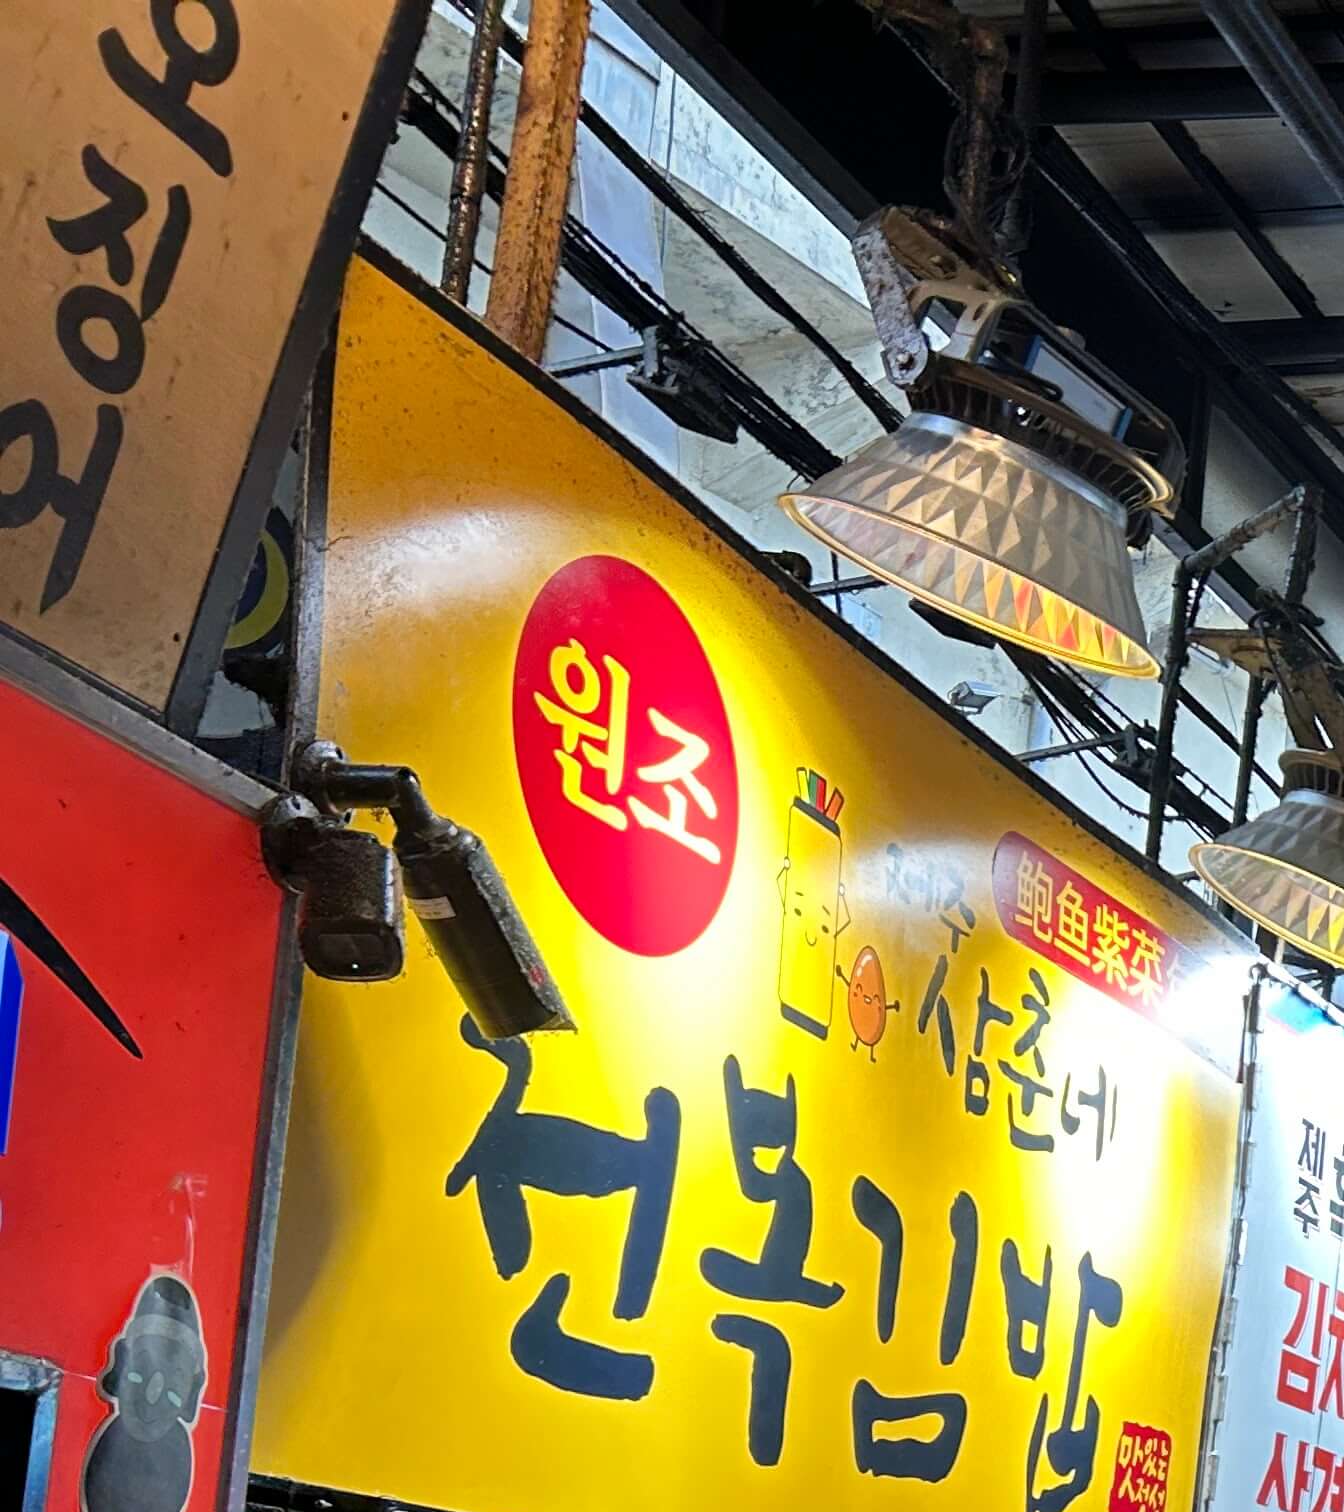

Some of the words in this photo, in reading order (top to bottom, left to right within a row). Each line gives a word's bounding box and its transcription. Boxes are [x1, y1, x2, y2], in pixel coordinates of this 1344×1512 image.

[533, 635, 722, 866] 원조
[1013, 850, 1180, 1006] 鲍鱼紫菜
[916, 953, 1119, 1162] 삼춘네
[1294, 1118, 1327, 1239] 제주
